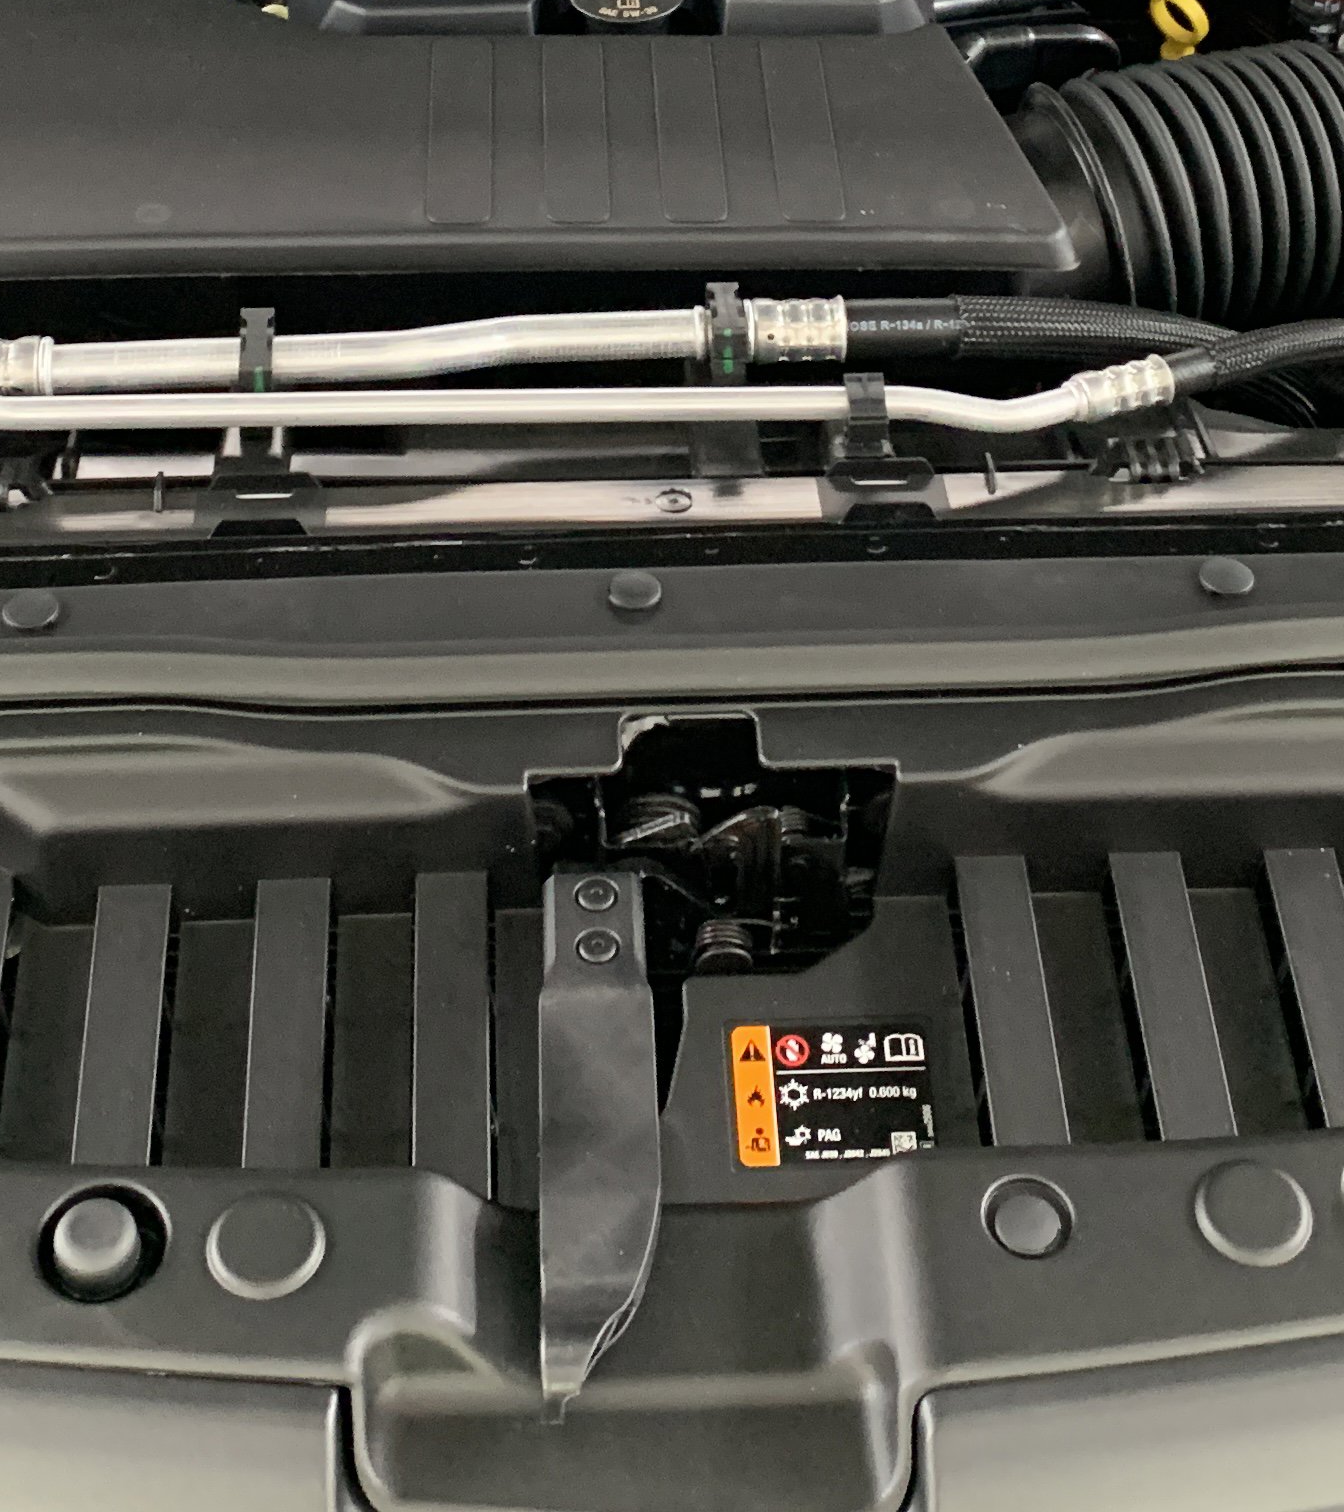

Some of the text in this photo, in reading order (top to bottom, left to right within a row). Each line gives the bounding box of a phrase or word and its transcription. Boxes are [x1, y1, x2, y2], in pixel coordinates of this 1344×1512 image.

[847, 320, 877, 332] OSE
[880, 319, 924, 331] R-134a
[820, 1053, 847, 1065] AUTO
[813, 1086, 863, 1101] R-1234yf
[902, 1085, 917, 1100] kg
[817, 1128, 842, 1142] PAG
